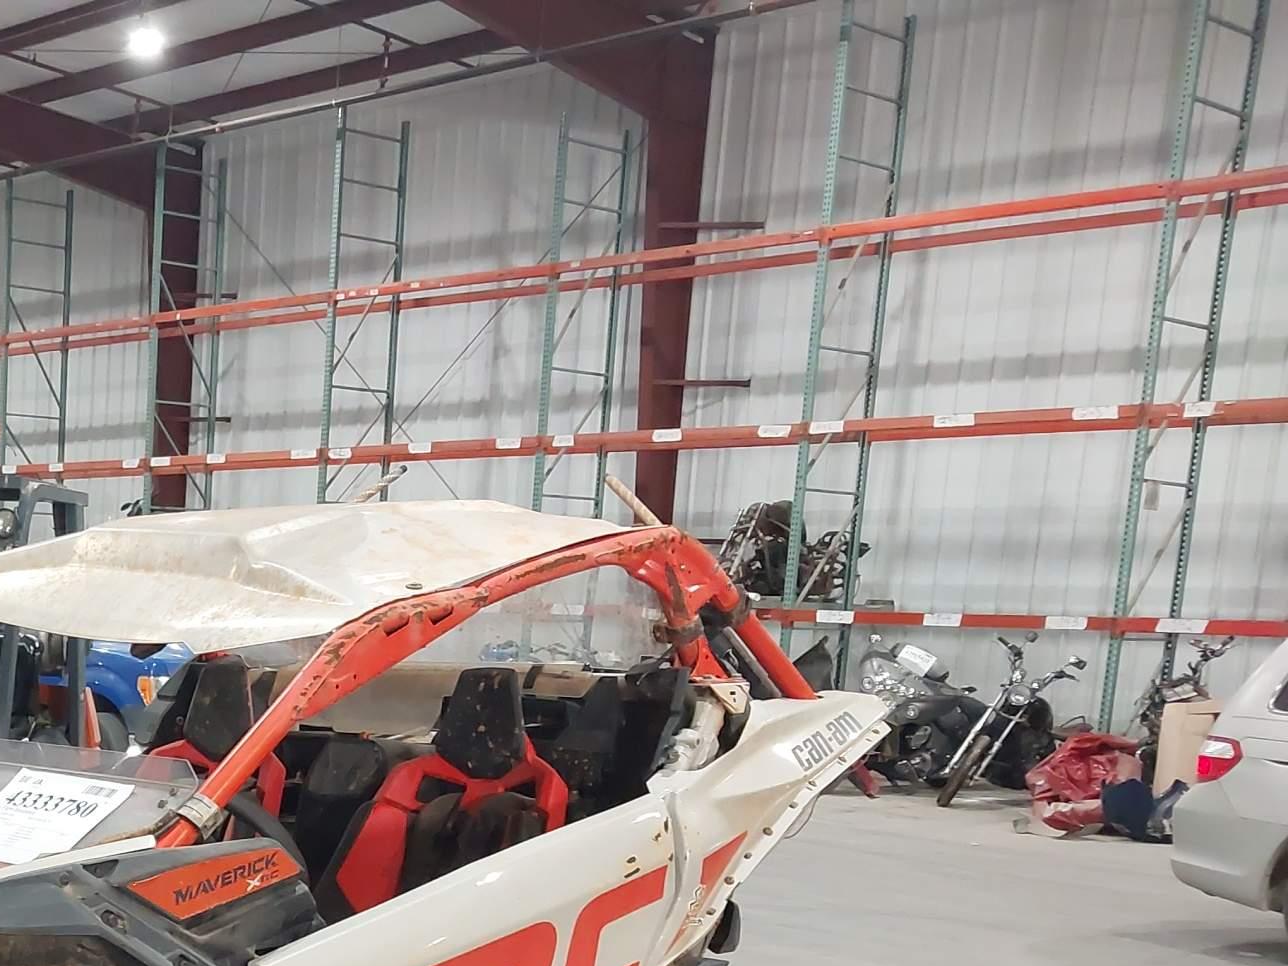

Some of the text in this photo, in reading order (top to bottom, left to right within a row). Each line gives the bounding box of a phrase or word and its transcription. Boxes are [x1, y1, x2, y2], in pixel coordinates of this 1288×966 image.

[792, 711, 863, 772] can-am
[6, 790, 98, 818] 43333780
[173, 850, 278, 905] MAVERICK
